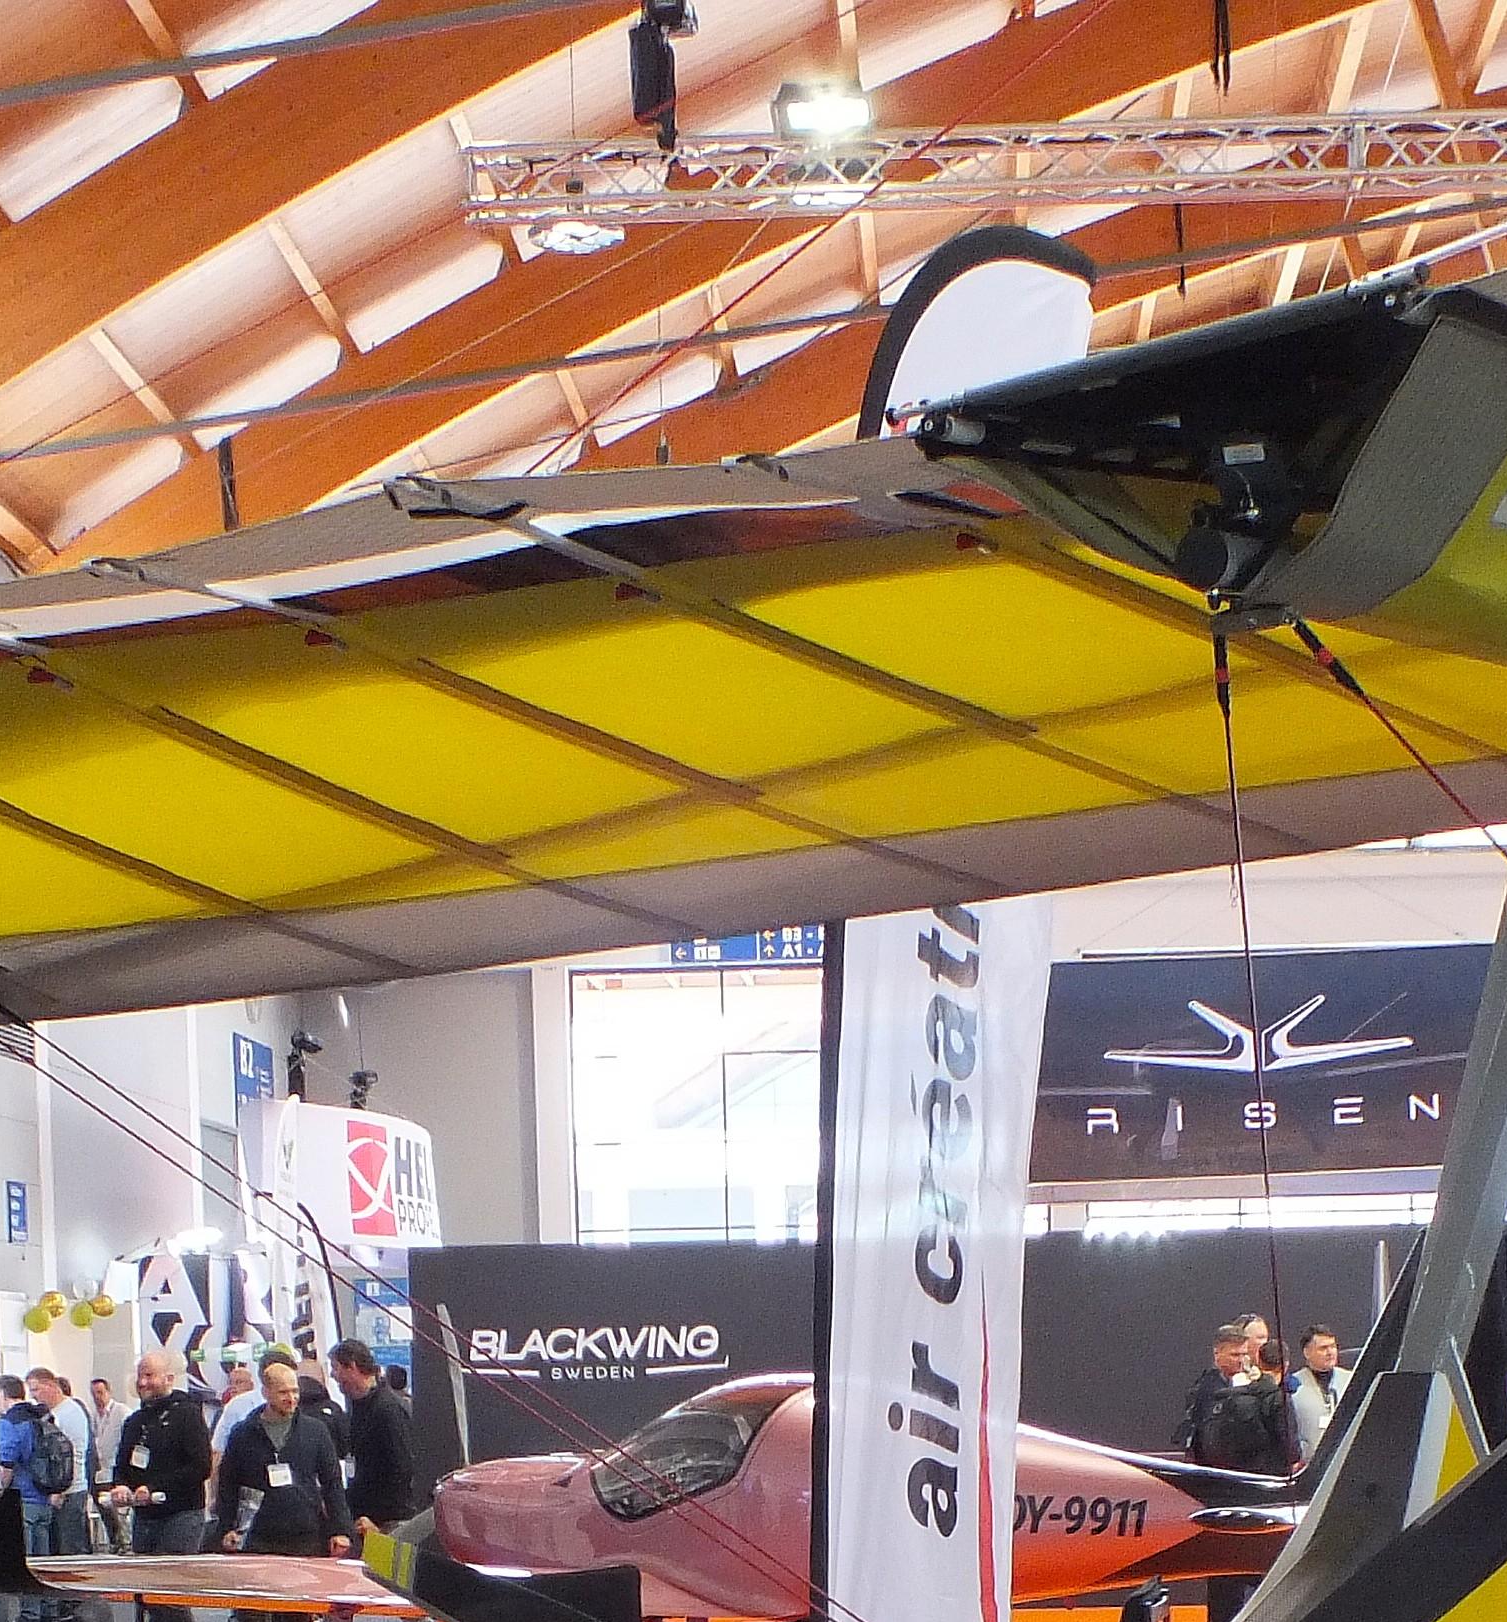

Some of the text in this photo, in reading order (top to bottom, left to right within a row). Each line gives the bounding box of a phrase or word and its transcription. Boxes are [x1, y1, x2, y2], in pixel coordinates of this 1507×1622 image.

[781, 943, 803, 958] A1
[1086, 1093, 1441, 1135] RISEN
[469, 1325, 720, 1362] BLACKWING
[550, 1366, 636, 1381] SWEDEN
[888, 1341, 965, 1539] air
